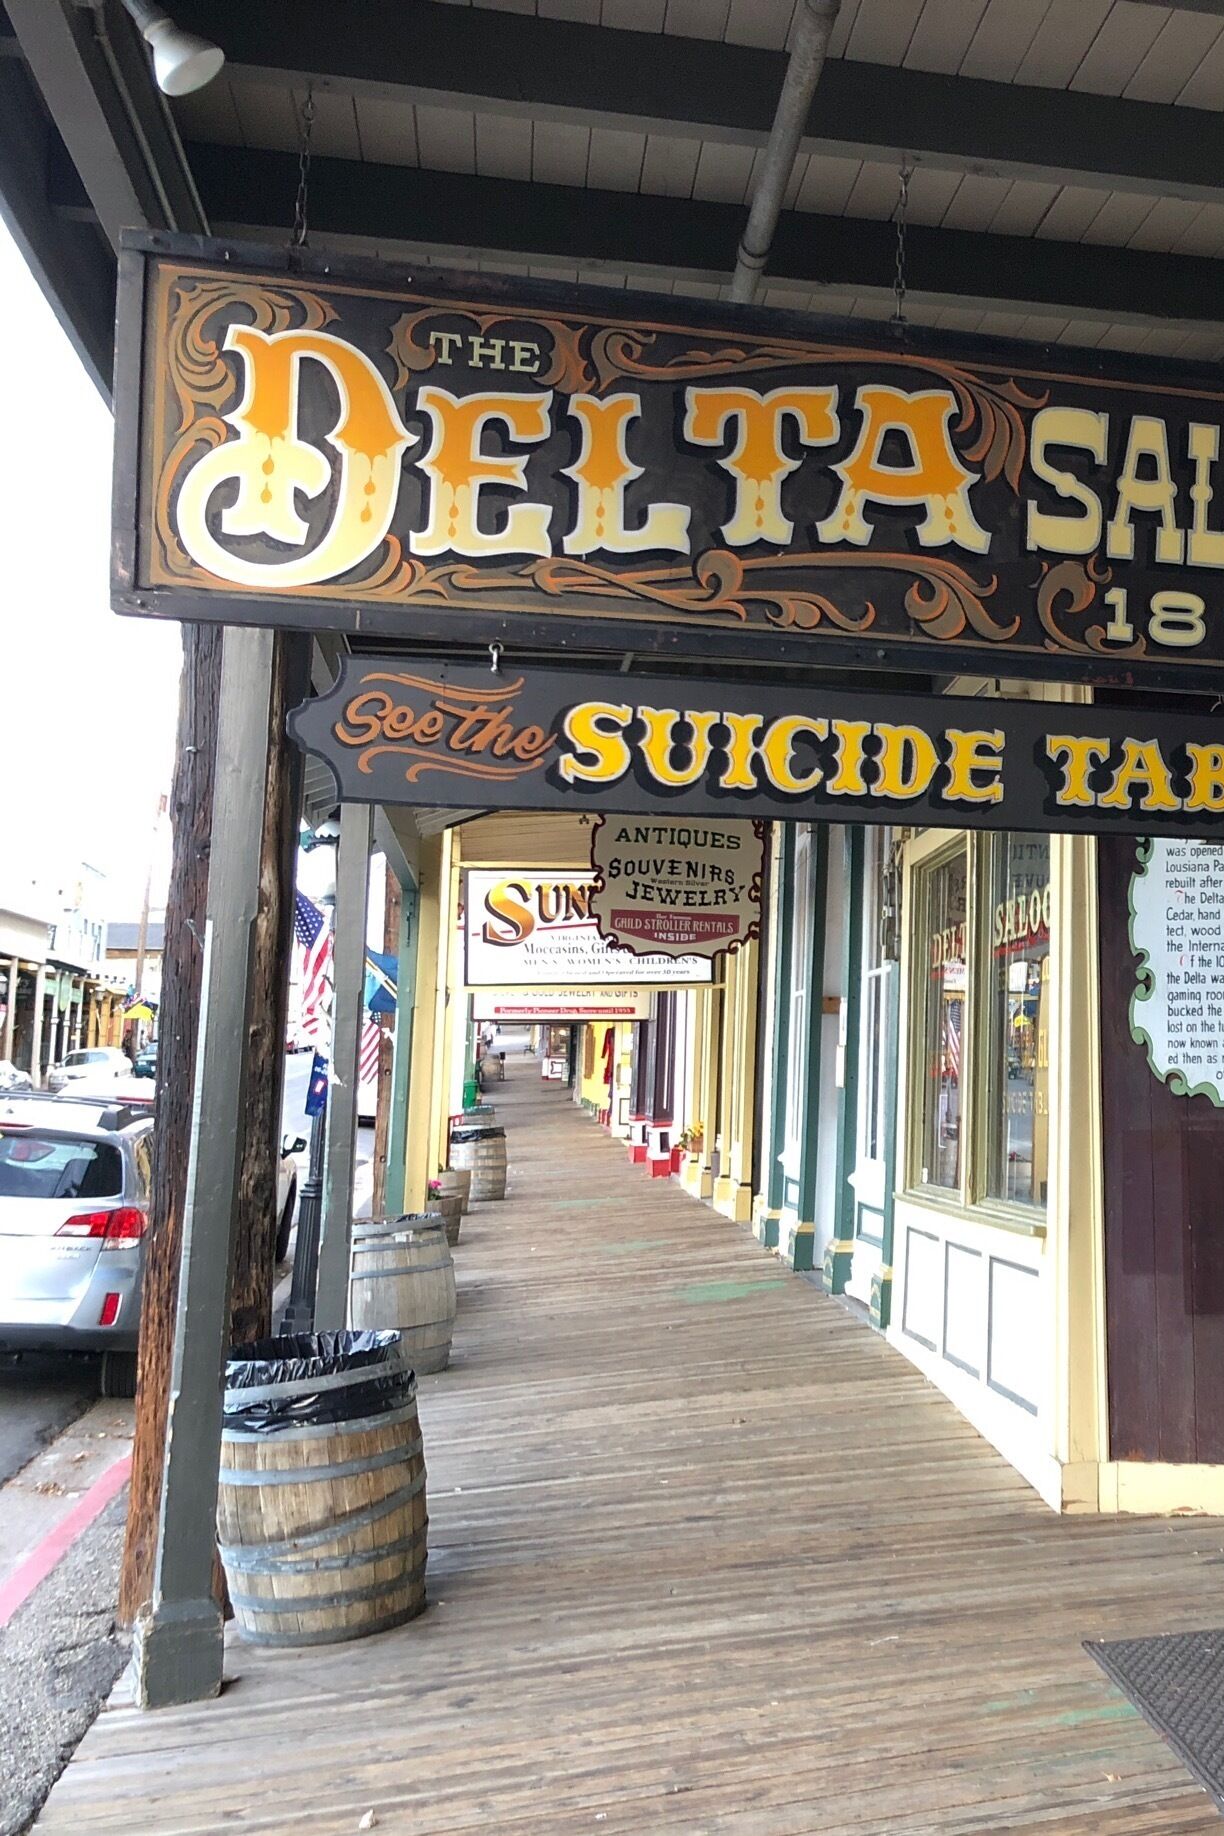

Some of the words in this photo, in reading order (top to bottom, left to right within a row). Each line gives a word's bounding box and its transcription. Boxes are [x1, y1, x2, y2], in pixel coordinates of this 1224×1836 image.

[429, 330, 541, 374] THE
[176, 323, 993, 589] DELTA
[335, 690, 444, 745] See
[559, 701, 1005, 803] SUICIDE
[615, 827, 741, 850] ANTIQUES
[1166, 848, 1186, 857] was
[1190, 846, 1221, 859] opened
[608, 857, 735, 886] SOUVENIRS
[1166, 860, 1210, 873] Lousiana
[1165, 876, 1196, 889] rebuilt
[1200, 876, 1222, 888] after
[626, 880, 745, 907] JEWELRY
[1200, 892, 1224, 904] Delta
[1166, 907, 1195, 921] Cedar,
[1198, 908, 1221, 920] hand
[644, 918, 690, 931] STROLLER
[693, 920, 734, 934] RENTALS
[1191, 924, 1221, 936] wood
[654, 931, 697, 941] INSIDE
[524, 942, 588, 955] Moccasins,
[1167, 940, 1183, 952] the
[1198, 955, 1212, 968] the
[1167, 972, 1181, 984] the
[1184, 971, 1206, 984] Delta
[1167, 989, 1201, 1004] gaming
[1167, 1004, 1204, 1017] bucked
[1207, 1004, 1222, 1016] the
[1167, 1020, 1183, 1033] lost
[1186, 1023, 1197, 1033] on
[1201, 1020, 1216, 1033] the
[1168, 1038, 1187, 1049] now
[1190, 1036, 1218, 1048] known
[1168, 1052, 1178, 1064] ed
[1183, 1052, 1202, 1064] then
[1207, 1053, 1218, 1064] as
